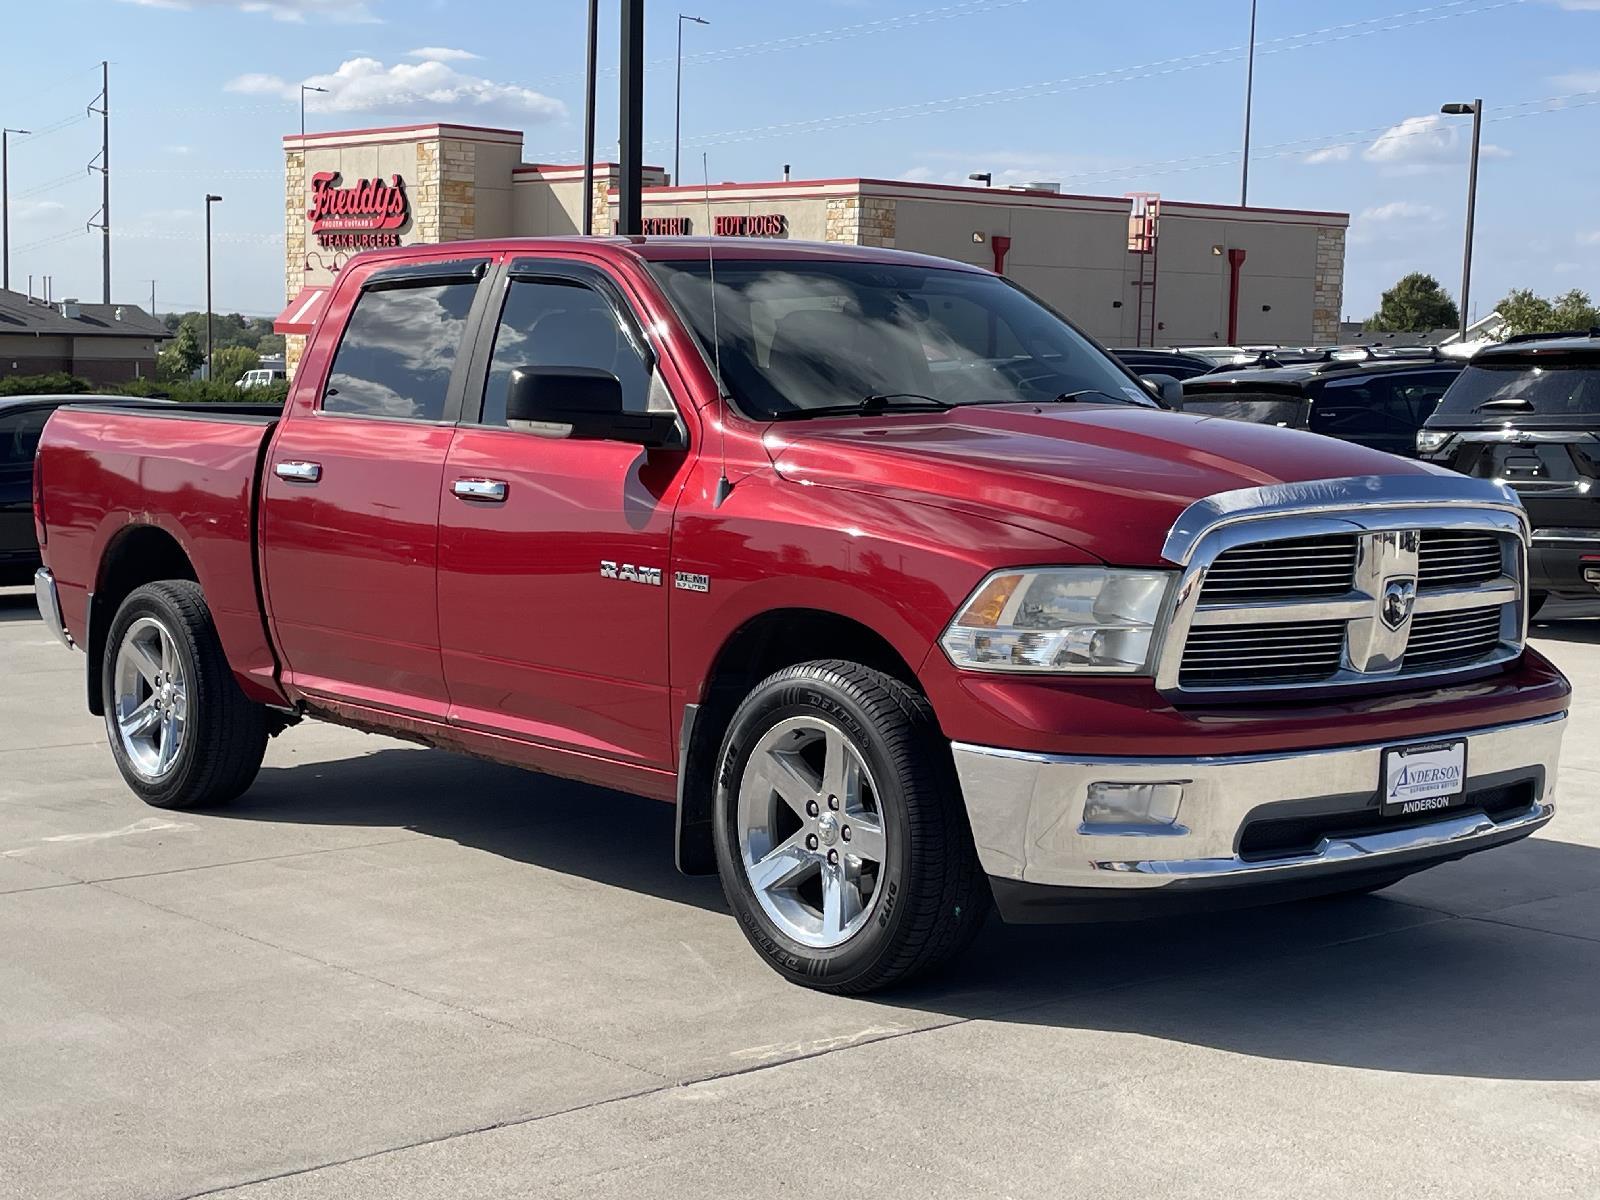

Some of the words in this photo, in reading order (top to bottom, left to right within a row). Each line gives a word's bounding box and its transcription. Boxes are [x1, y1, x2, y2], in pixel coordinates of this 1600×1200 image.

[307, 171, 404, 222] Freddy's
[651, 218, 687, 236] THRU
[714, 216, 743, 236] HOT
[746, 214, 782, 235] DOGS
[317, 233, 397, 247] STEAKBURGERS
[600, 560, 662, 586] RAM
[1390, 764, 1460, 797] ANDERSON
[1403, 797, 1448, 814] ANDERSON
